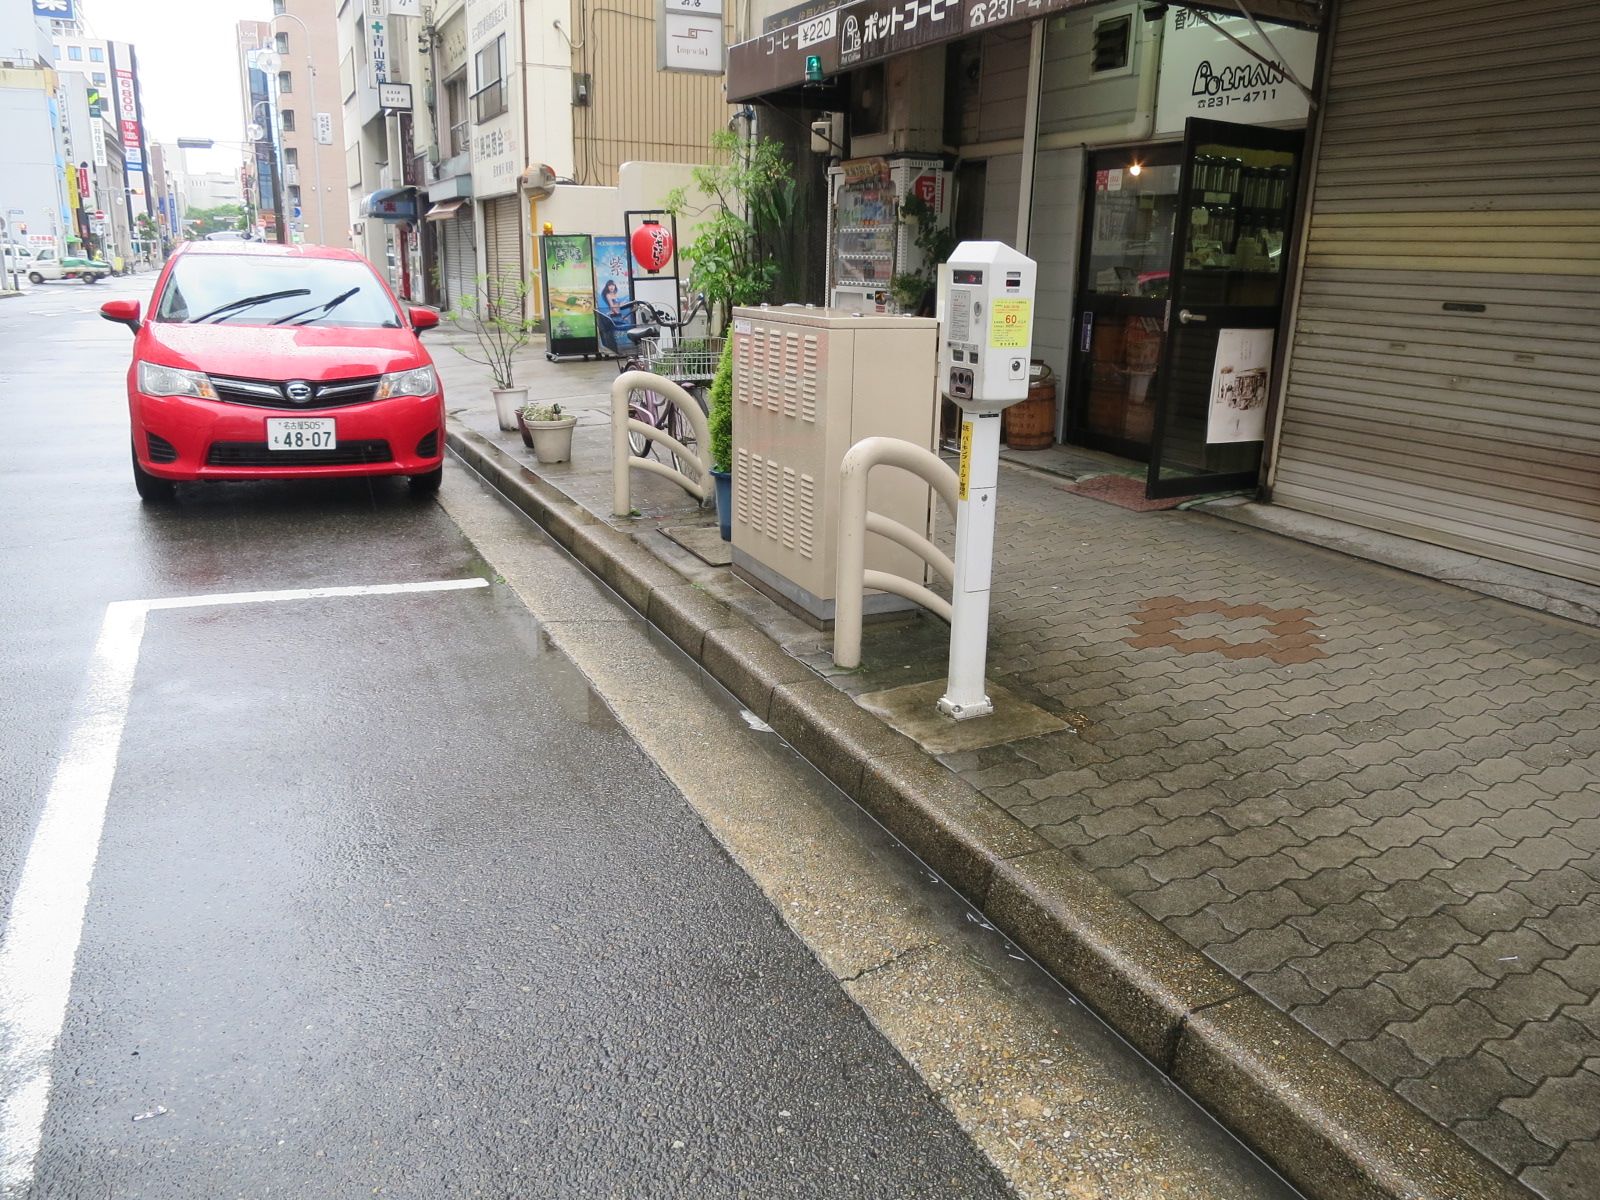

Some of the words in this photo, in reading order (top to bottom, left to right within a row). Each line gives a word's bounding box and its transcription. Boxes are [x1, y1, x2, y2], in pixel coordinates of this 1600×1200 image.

[802, 17, 831, 44] ¥220
[766, 30, 799, 56] コーヒー
[373, 34, 387, 83] 青山薬局
[1207, 89, 1277, 108] 231-4711
[1005, 314, 1018, 325] 60
[283, 431, 331, 448] 48-07
